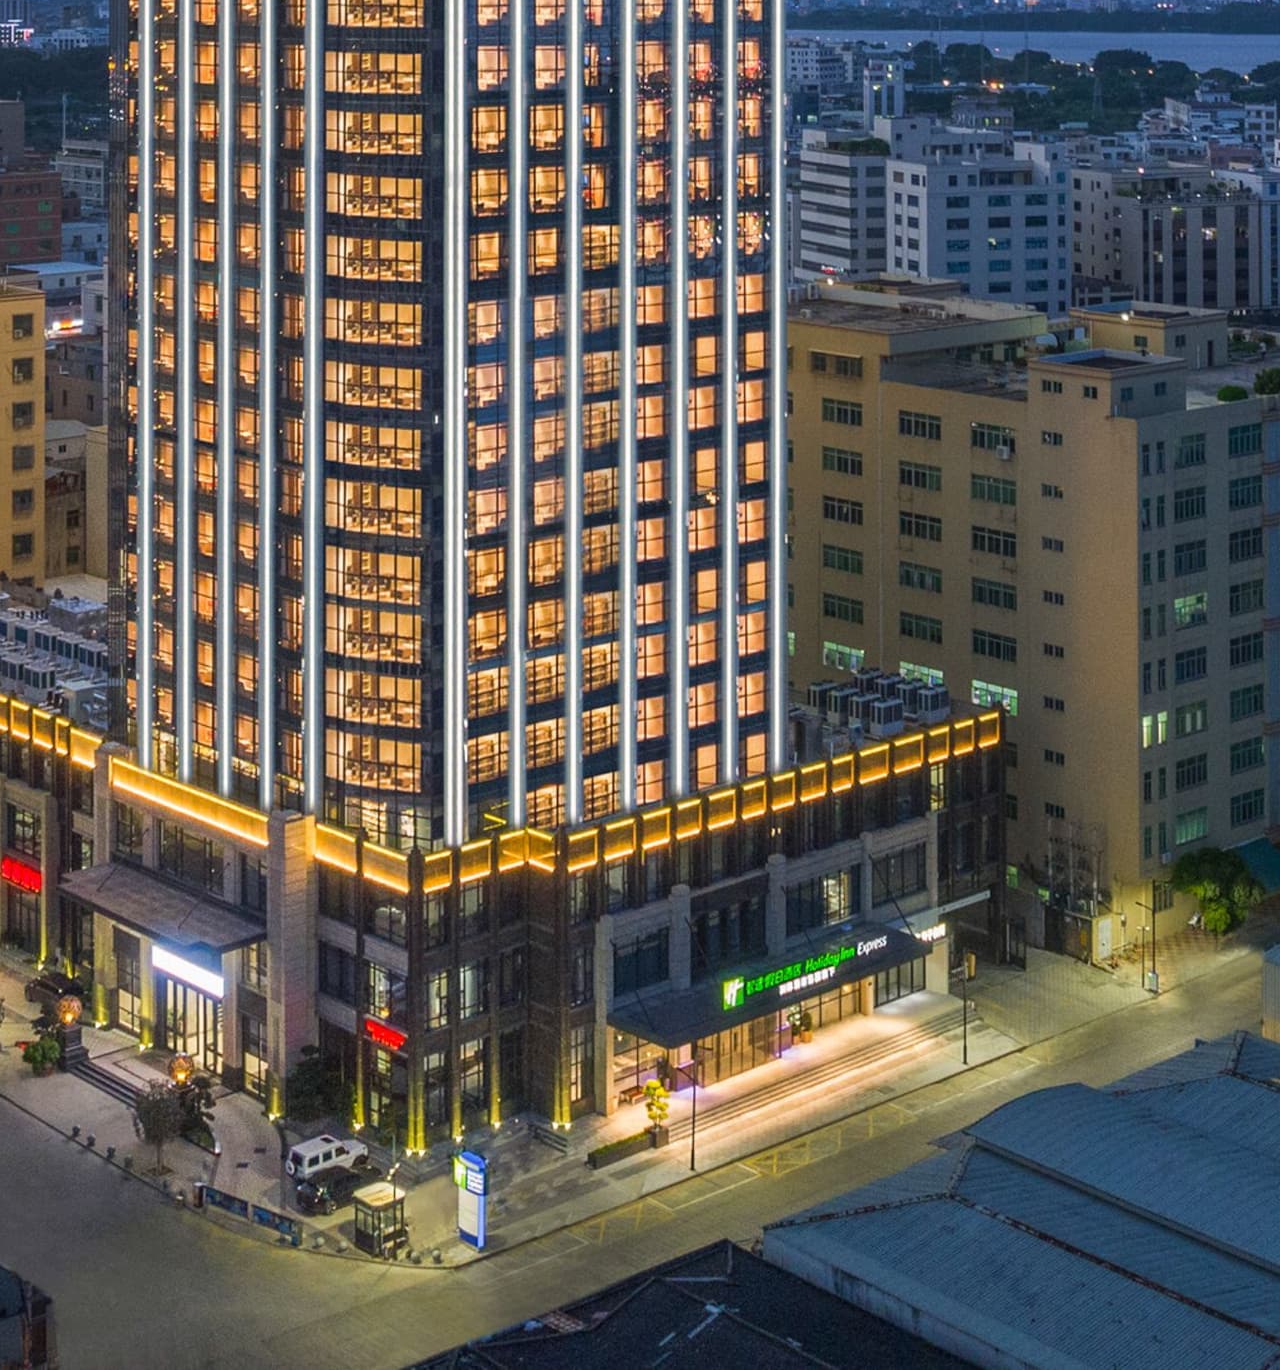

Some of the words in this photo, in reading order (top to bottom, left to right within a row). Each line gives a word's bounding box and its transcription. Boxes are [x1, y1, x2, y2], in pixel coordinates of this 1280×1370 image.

[805, 951, 841, 974] Holiday
[840, 946, 855, 963] Inn
[856, 935, 888, 957] Express
